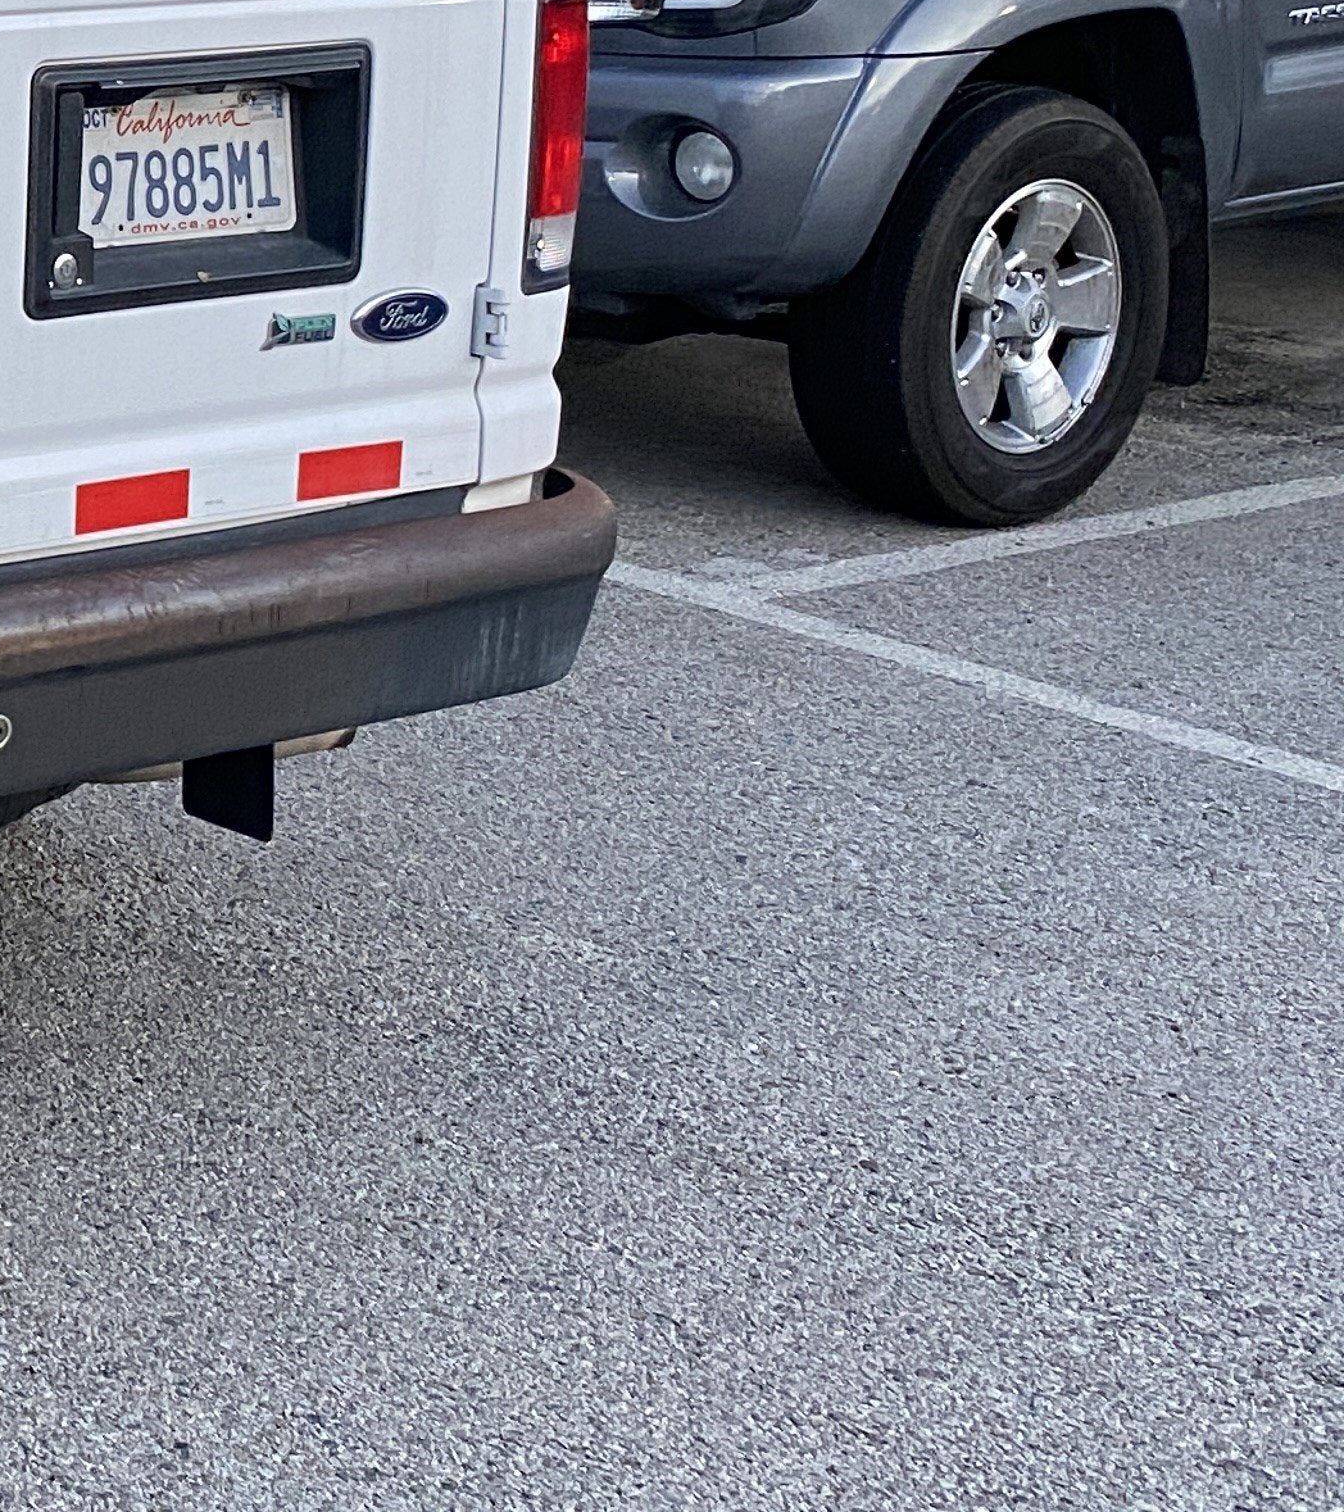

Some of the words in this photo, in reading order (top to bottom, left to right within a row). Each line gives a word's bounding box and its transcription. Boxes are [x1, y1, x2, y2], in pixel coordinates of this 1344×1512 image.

[116, 99, 251, 144] California
[88, 140, 281, 226] 97885M1
[130, 215, 242, 235] dmv.ca.gov
[379, 300, 430, 331] Ford
